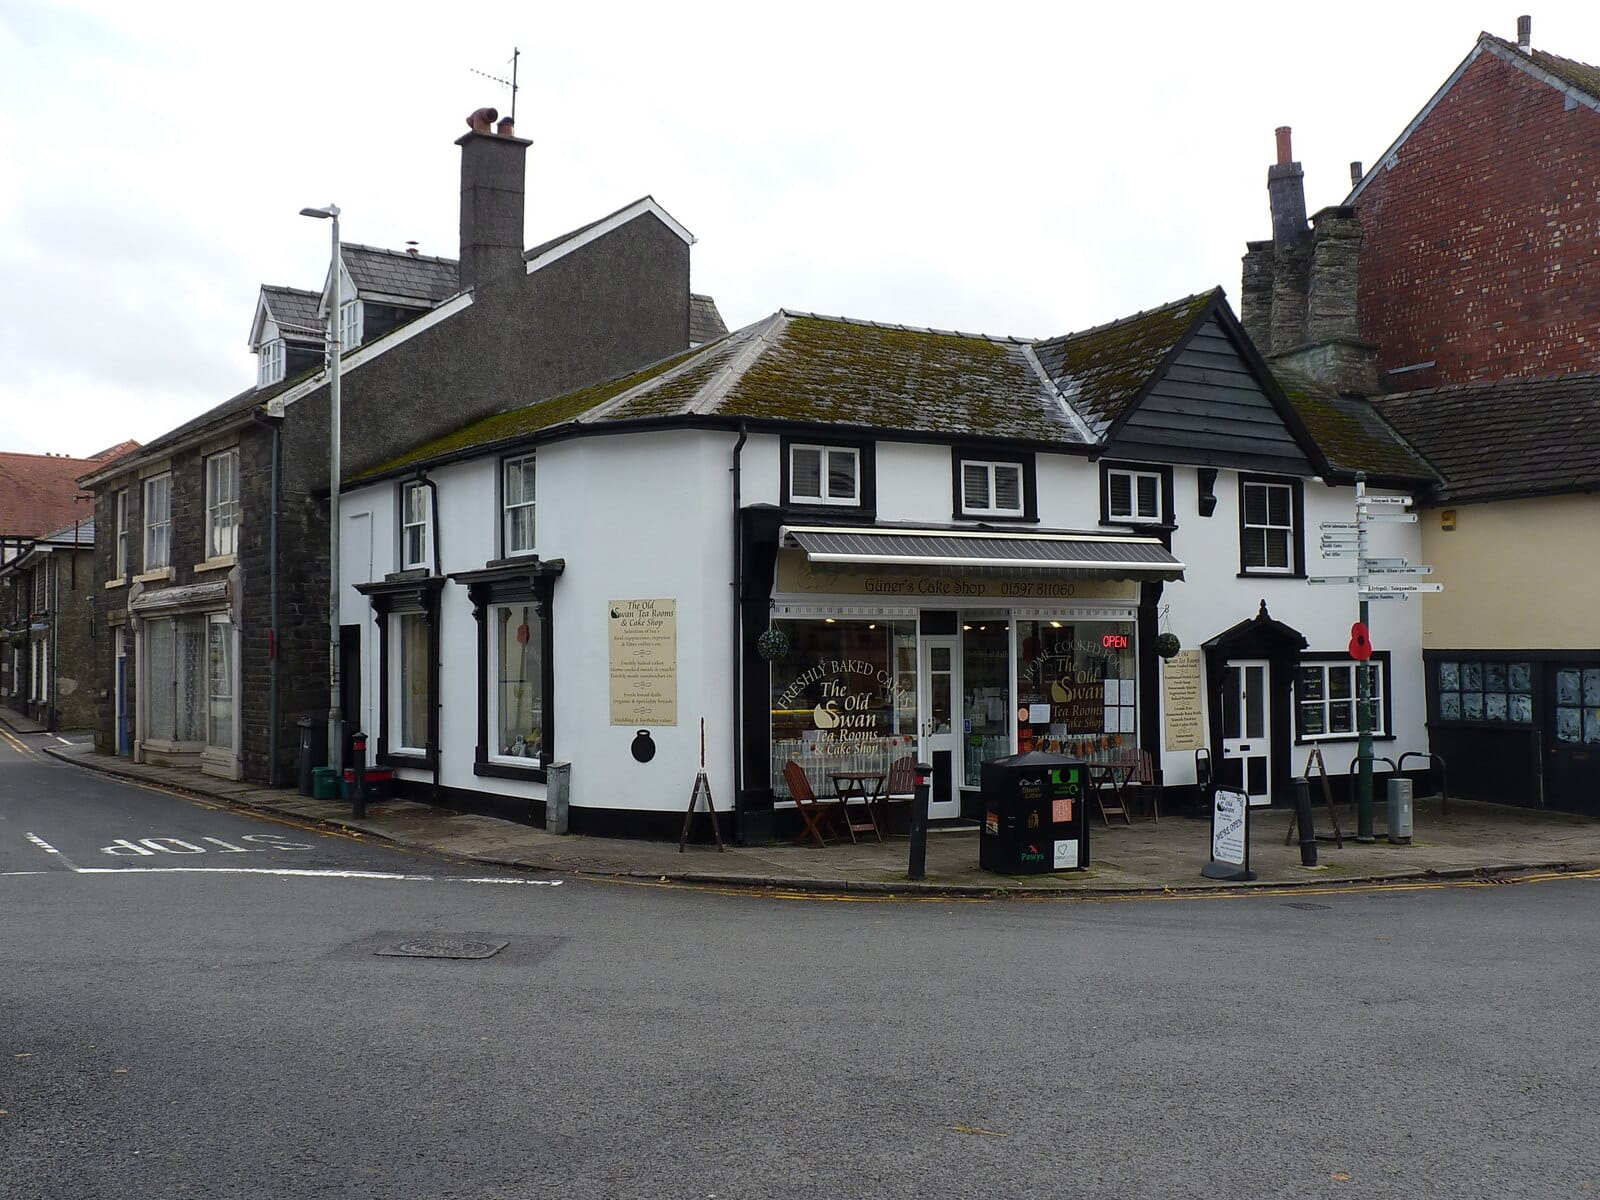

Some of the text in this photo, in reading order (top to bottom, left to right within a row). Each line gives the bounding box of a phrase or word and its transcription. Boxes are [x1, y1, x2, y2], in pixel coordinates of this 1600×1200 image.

[918, 579, 950, 595] Cake
[952, 579, 985, 597] Shop
[1001, 582, 1034, 596] 01597
[1036, 583, 1075, 596] 811060
[627, 600, 655, 610] The Old
[611, 607, 674, 619] Swan Tea Rooms
[621, 618, 664, 630] & Cake Shop
[1102, 634, 1127, 648] OPEN
[1023, 649, 1051, 681] HOME
[1053, 639, 1102, 655] COOKED
[1056, 656, 1102, 684] The Old
[777, 659, 913, 710] FRESHLY BAKED CAKES
[1051, 676, 1104, 703] Swan
[820, 679, 873, 711] The Old
[813, 700, 877, 729] Swan
[1052, 705, 1104, 718] Tea Rooms
[1085, 718, 1104, 730] Shop
[816, 729, 879, 743] Tea Rooms
[814, 742, 879, 757] & Cake Shop
[1230, 818, 1243, 832] OPEN
[99, 834, 315, 856] STOP
[1021, 851, 1045, 863] Powys
